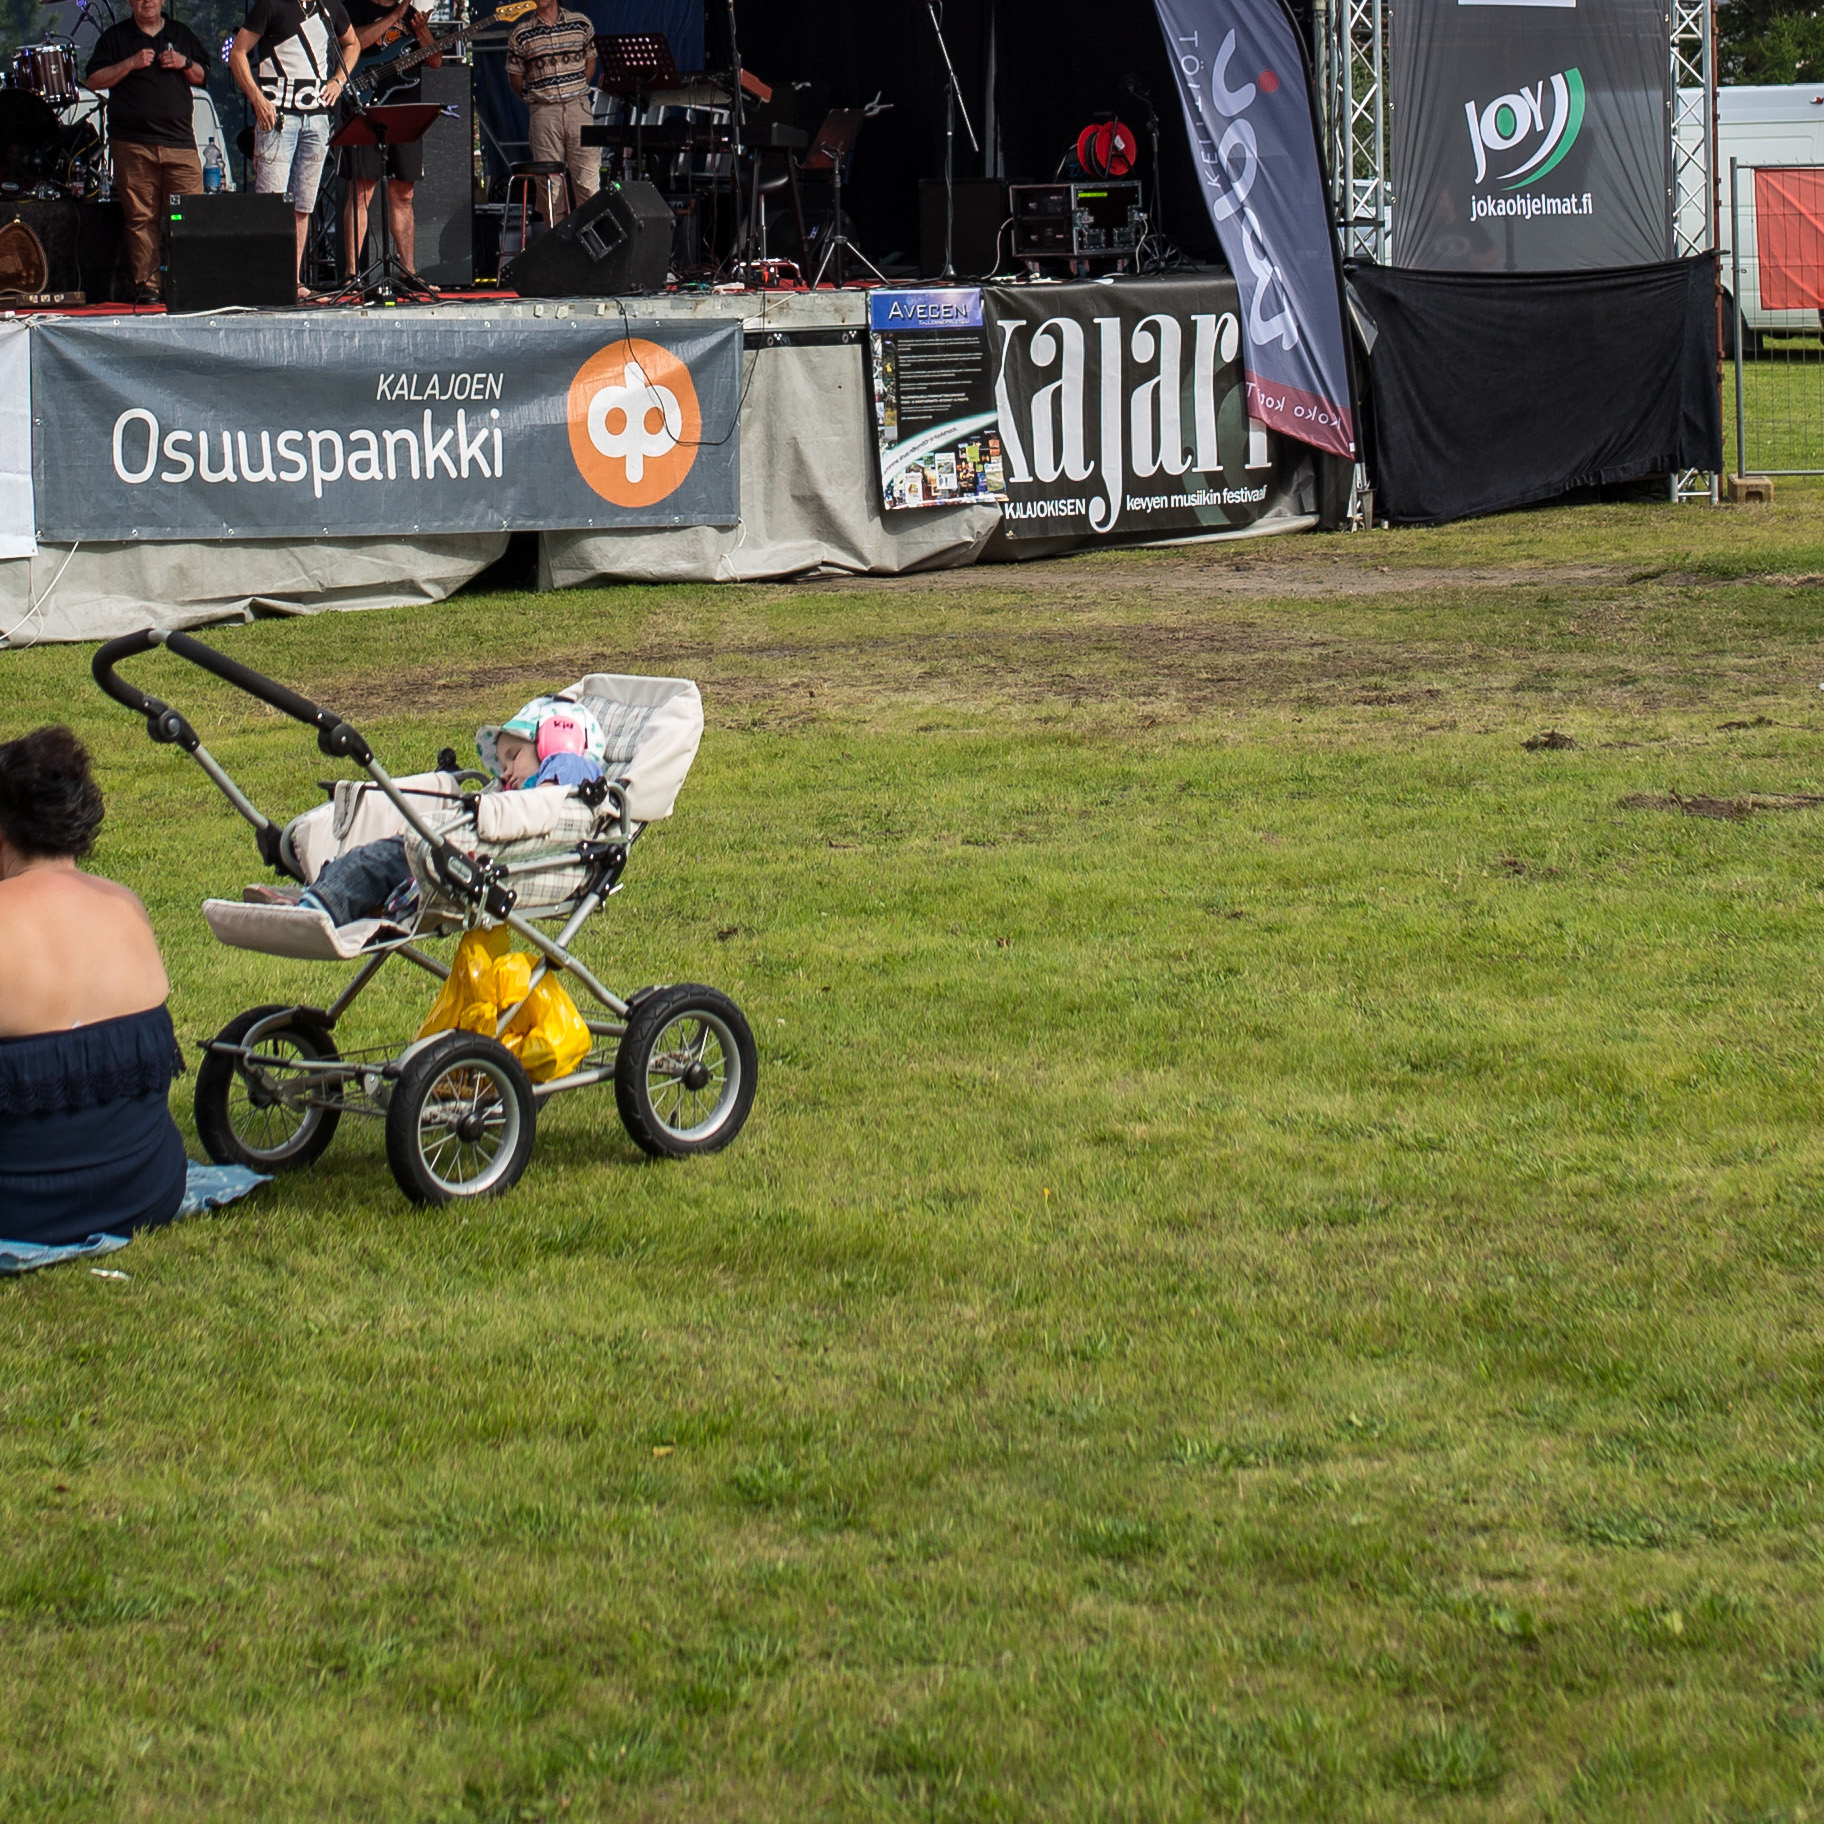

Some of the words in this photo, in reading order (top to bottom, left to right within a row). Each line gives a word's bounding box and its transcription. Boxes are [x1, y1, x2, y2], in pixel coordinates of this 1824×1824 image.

[1465, 80, 1544, 184] JOY
[1470, 192, 1593, 222] jokaohjelmat.fi
[377, 373, 504, 401] KALAJOEN
[112, 408, 504, 499] Osuuspankki
[1004, 498, 1086, 521] KALAJOKISEN
[1126, 493, 1169, 514] kevyen
[1170, 489, 1221, 508] musiikin
